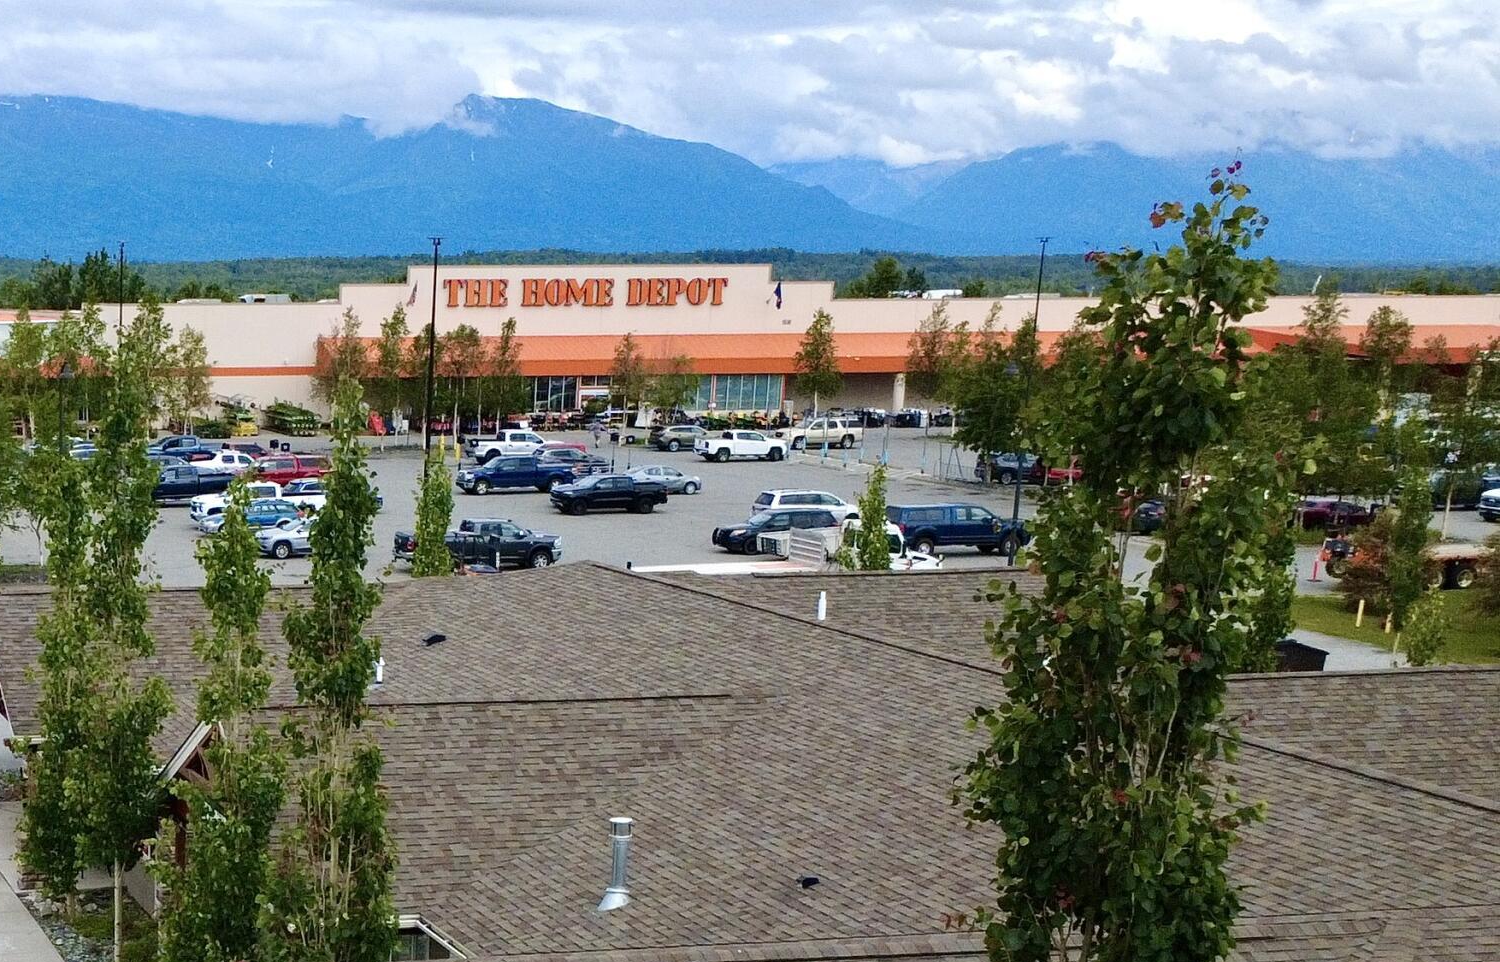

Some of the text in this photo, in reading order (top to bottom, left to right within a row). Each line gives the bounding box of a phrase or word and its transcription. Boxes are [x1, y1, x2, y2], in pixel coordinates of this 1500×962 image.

[443, 277, 729, 307] THE HOME DEPOT
